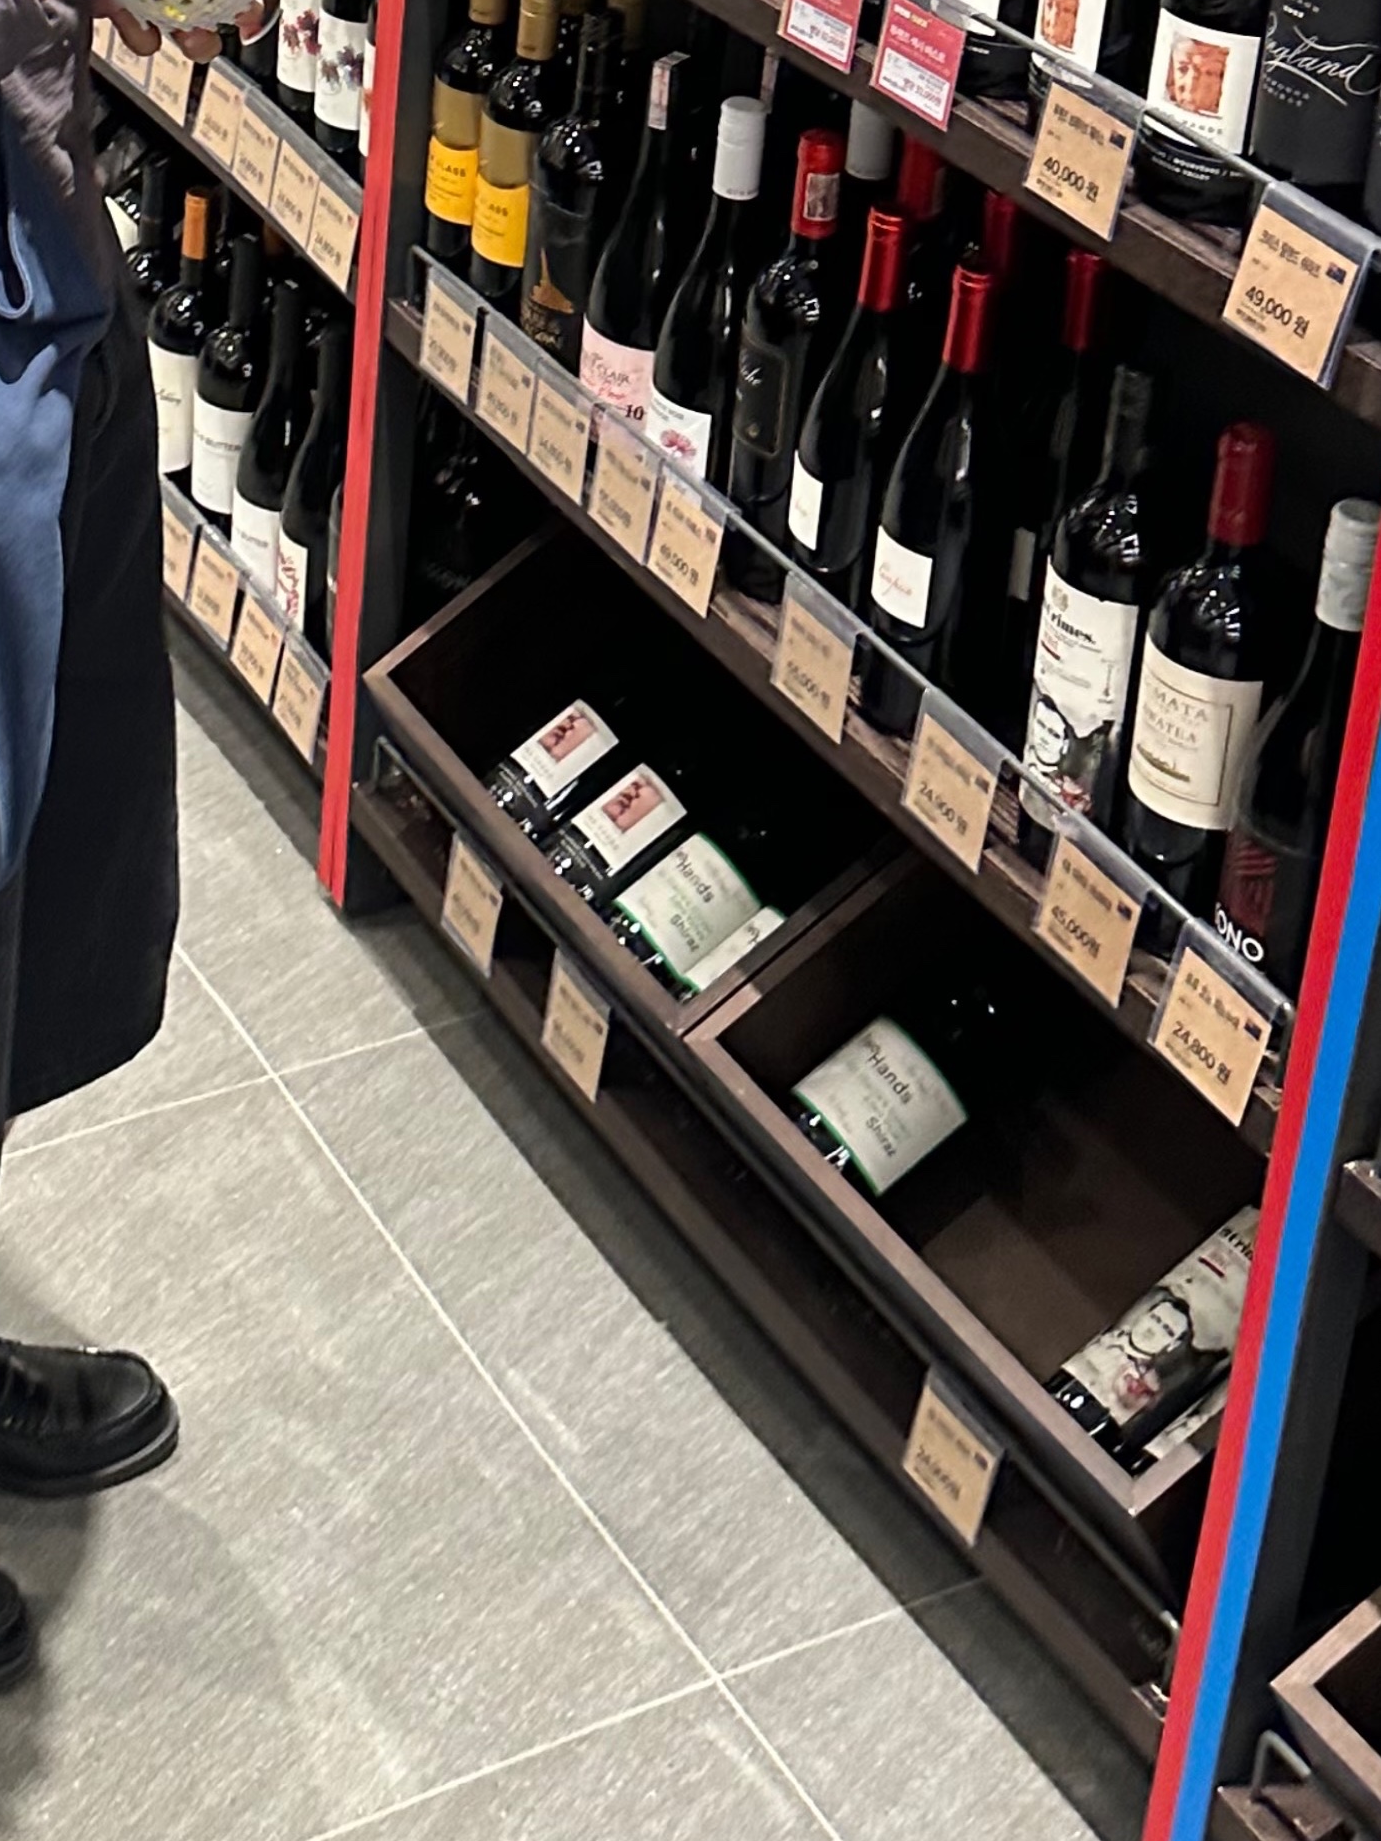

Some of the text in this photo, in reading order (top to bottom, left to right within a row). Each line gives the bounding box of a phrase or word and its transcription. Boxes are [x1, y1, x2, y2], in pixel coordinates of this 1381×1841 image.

[1043, 156, 1085, 192] 40,000
[1244, 285, 1310, 340] 49,000 원
[625, 404, 644, 421] 10
[677, 858, 715, 906] Hands
[867, 1051, 915, 1106] Hands
[865, 1115, 899, 1158] Shiraz
